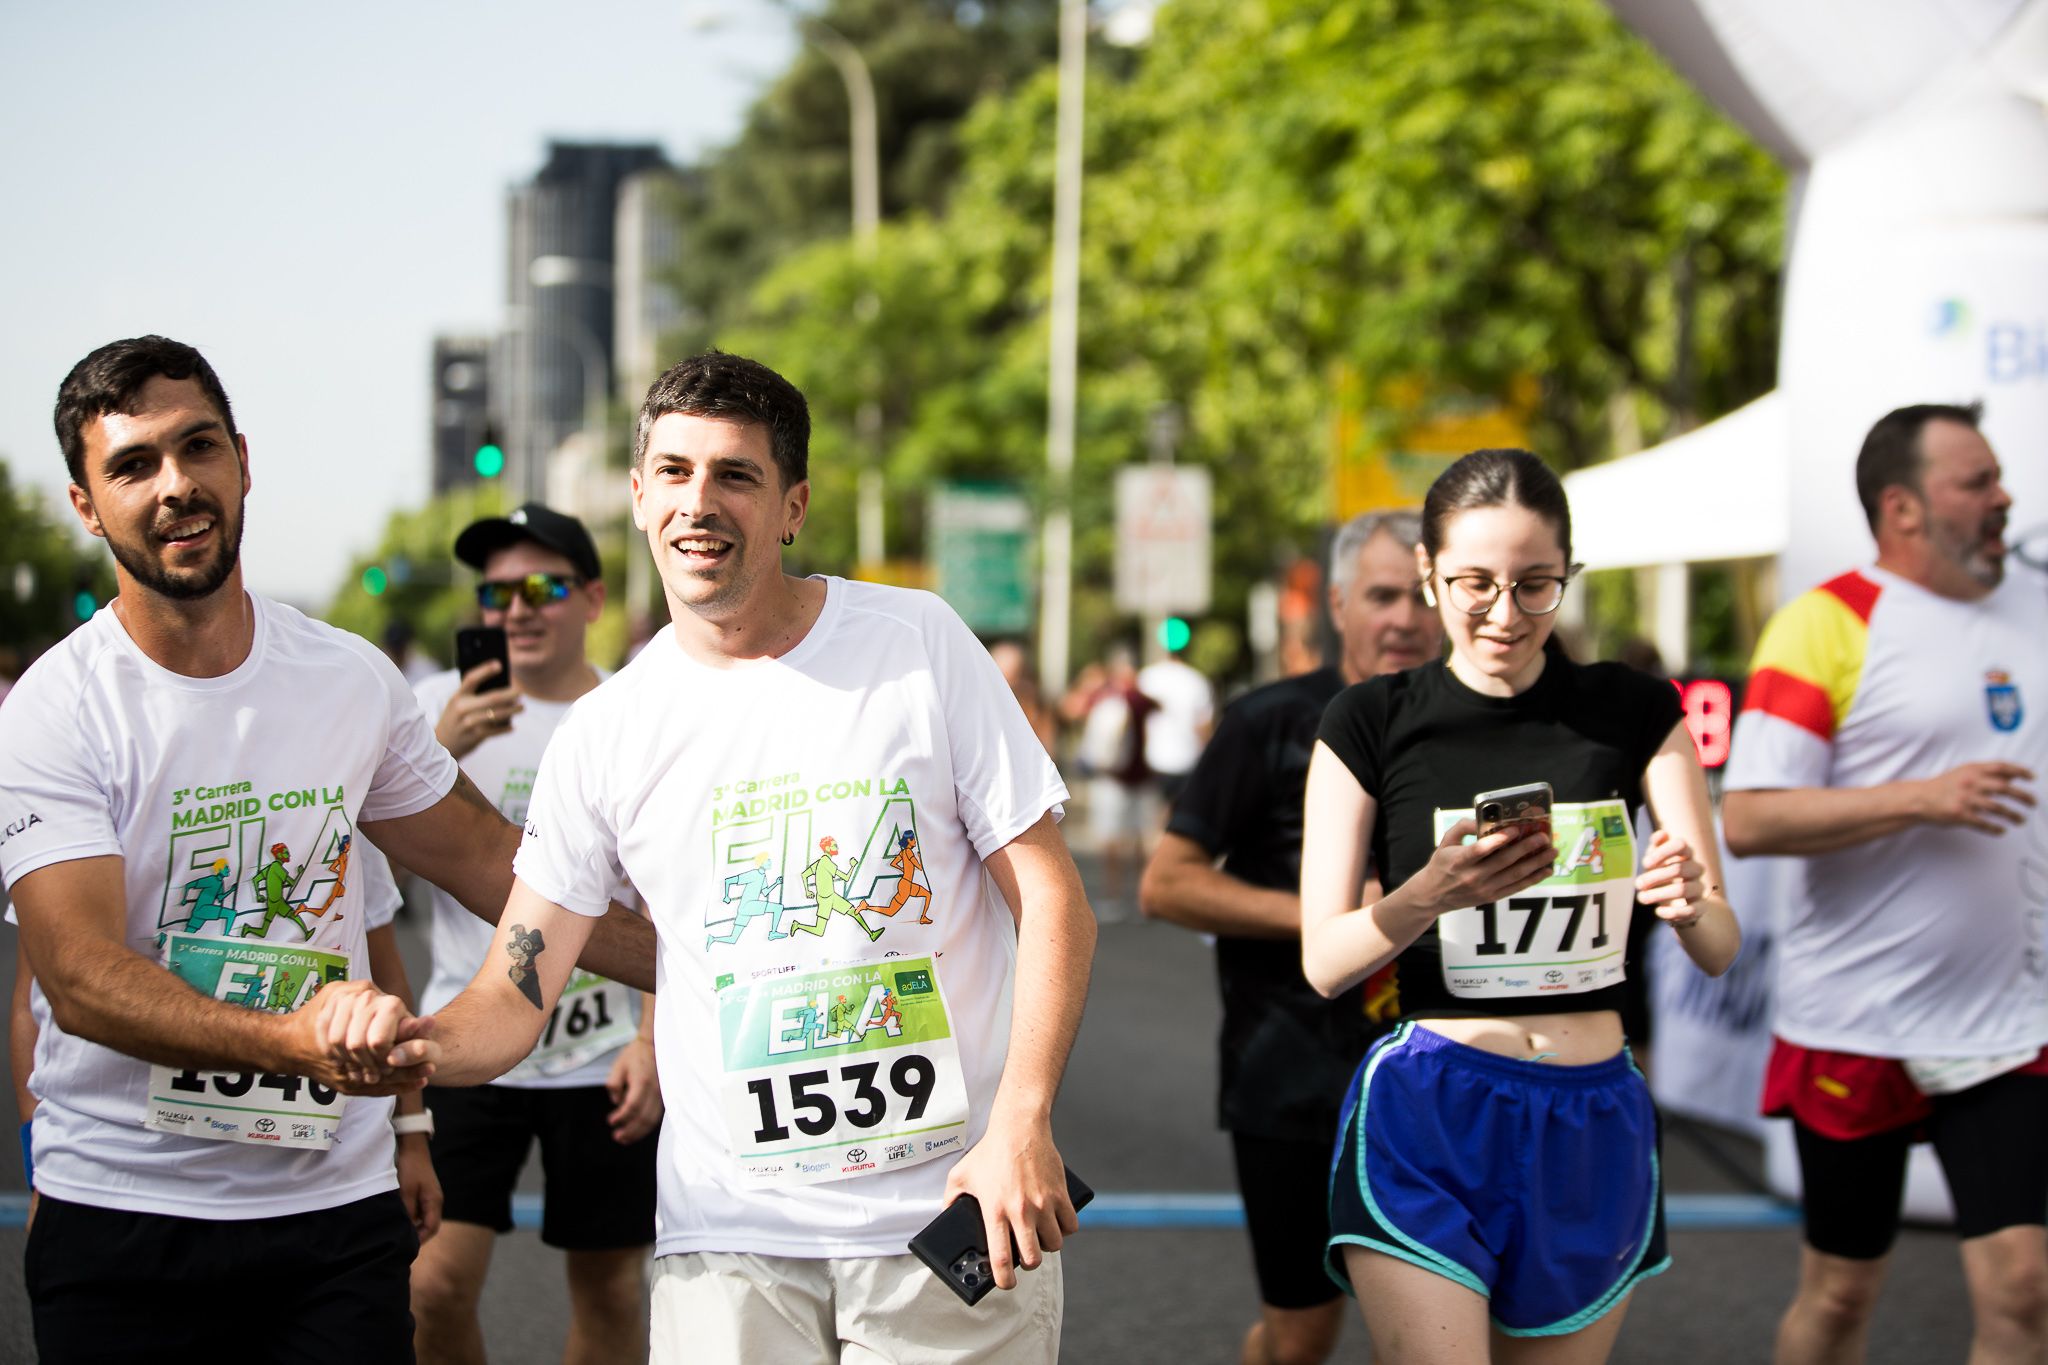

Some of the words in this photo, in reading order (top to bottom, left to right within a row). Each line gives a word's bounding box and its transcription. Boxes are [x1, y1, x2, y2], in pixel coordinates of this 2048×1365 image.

[195, 780, 252, 801] Carrera
[735, 772, 800, 795] Carrera
[172, 797, 261, 830] MADRID
[268, 788, 316, 811] CON
[322, 785, 344, 804] LA
[712, 789, 808, 826] MADRID
[815, 779, 871, 803] CON
[879, 778, 910, 796] LA
[1475, 892, 1609, 956] 1771
[189, 945, 224, 956] Carrera
[226, 948, 279, 964] MADRID
[280, 953, 306, 966] CON
[306, 956, 319, 968] LA
[771, 979, 829, 999] MADRID
[832, 973, 862, 988] CON
[865, 970, 882, 983] LA
[902, 980, 928, 992] adELA
[767, 983, 903, 1057] ELA
[747, 1054, 936, 1144] 1539
[157, 1110, 195, 1122] MUKUA
[211, 1120, 239, 1131] Biogen
[884, 1143, 908, 1154] SPORT
[888, 1150, 906, 1160] LIFE
[802, 1162, 832, 1172] Biogen
